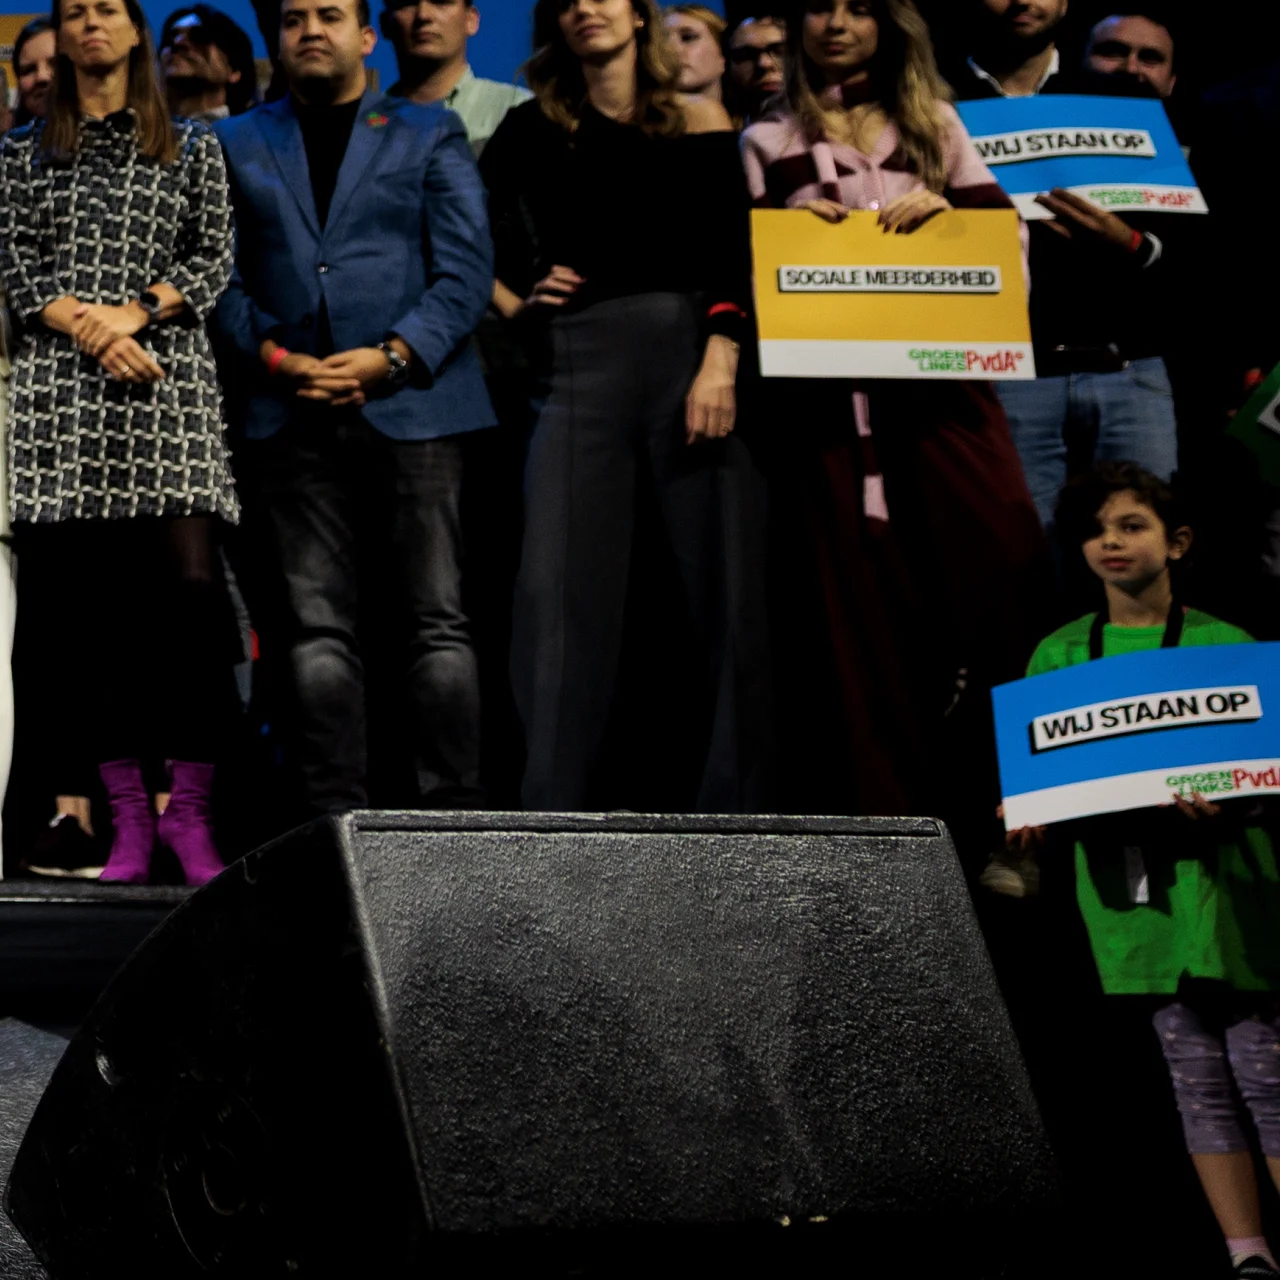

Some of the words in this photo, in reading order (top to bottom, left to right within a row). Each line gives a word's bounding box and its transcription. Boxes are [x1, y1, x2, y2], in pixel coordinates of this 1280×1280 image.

[975, 137, 1021, 157] WIJ
[1025, 131, 1108, 152] STAAN
[1112, 131, 1144, 149] OP
[786, 269, 863, 286] SOCIALE
[866, 270, 996, 287] MEERDERHEID
[908, 348, 966, 361] GROEN
[965, 349, 1017, 373] PvdA
[918, 359, 966, 373] LINKS
[1042, 711, 1094, 741] WIJ
[1099, 695, 1199, 729] STAAN
[1205, 692, 1251, 715] OP
[1165, 770, 1233, 788] GROEN
